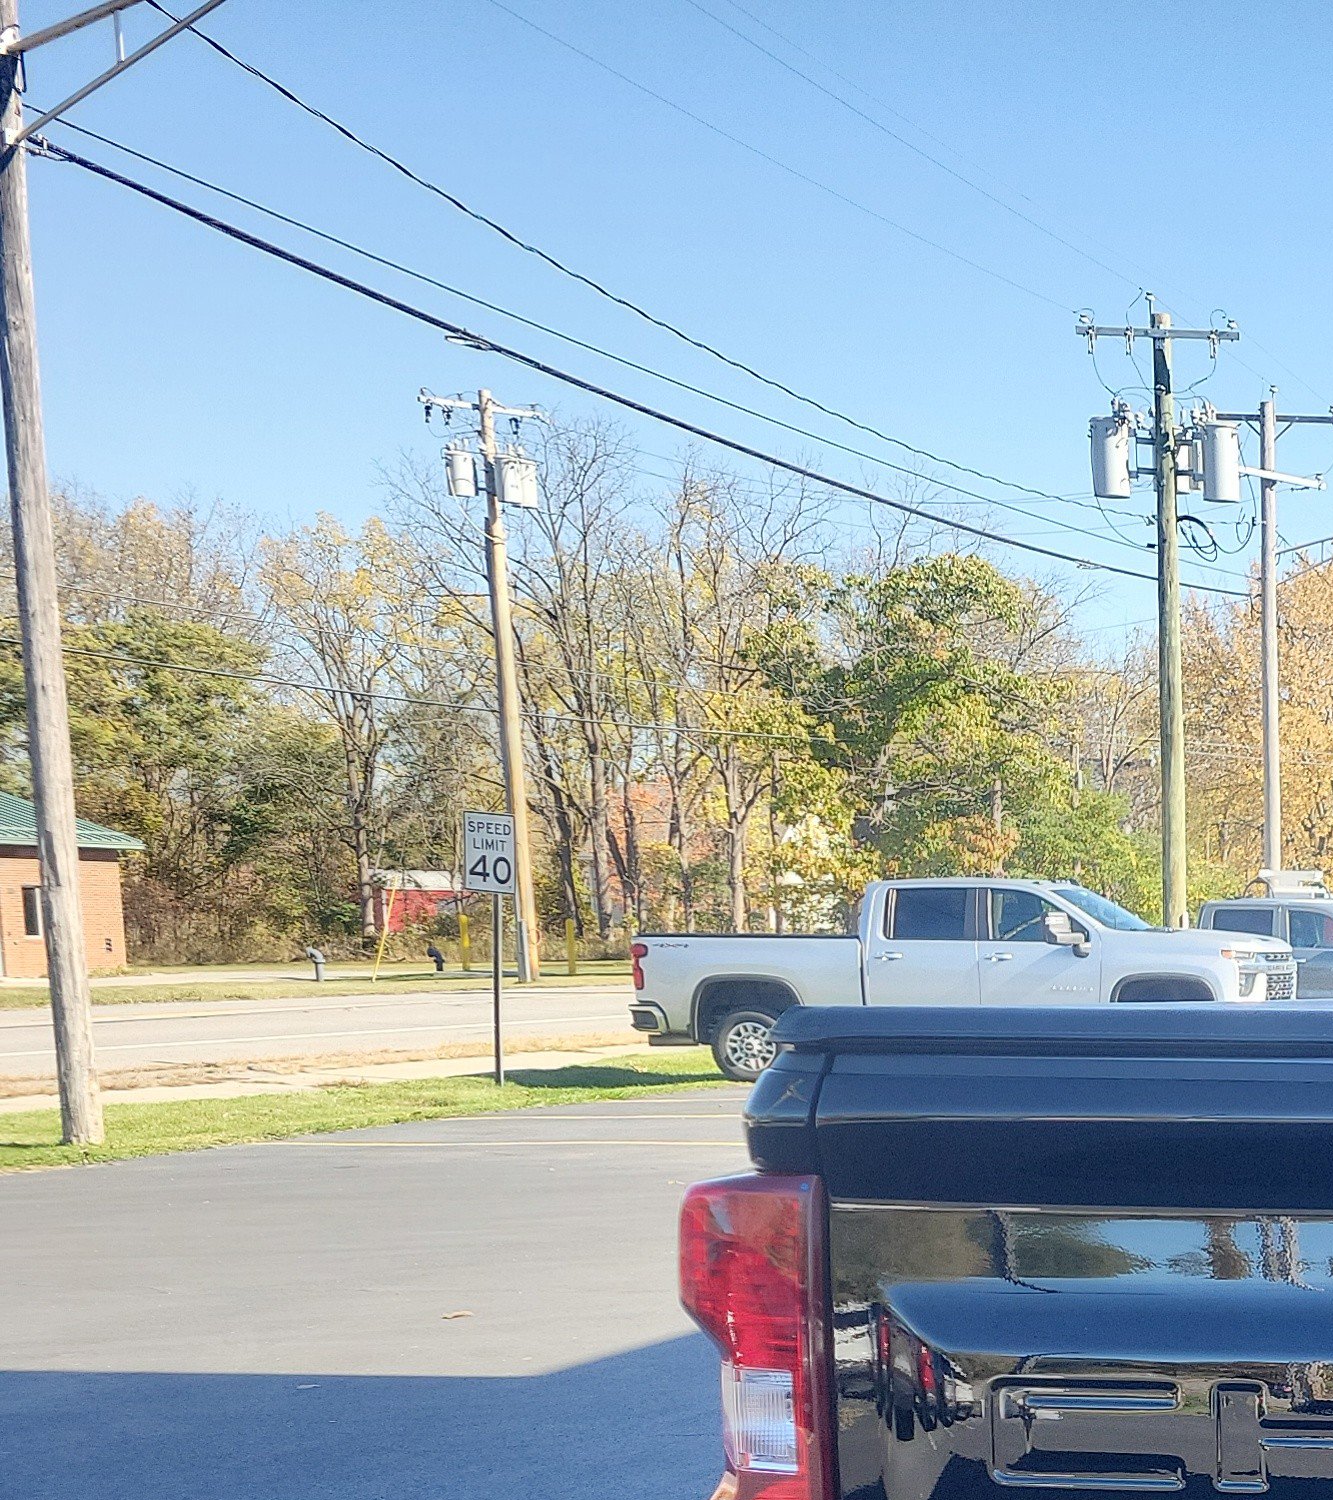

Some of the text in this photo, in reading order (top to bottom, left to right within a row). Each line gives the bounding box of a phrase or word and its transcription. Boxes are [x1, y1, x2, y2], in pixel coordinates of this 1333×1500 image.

[468, 821, 511, 835] SPEED
[473, 838, 507, 852] LIMIT
[469, 855, 511, 885] 40
